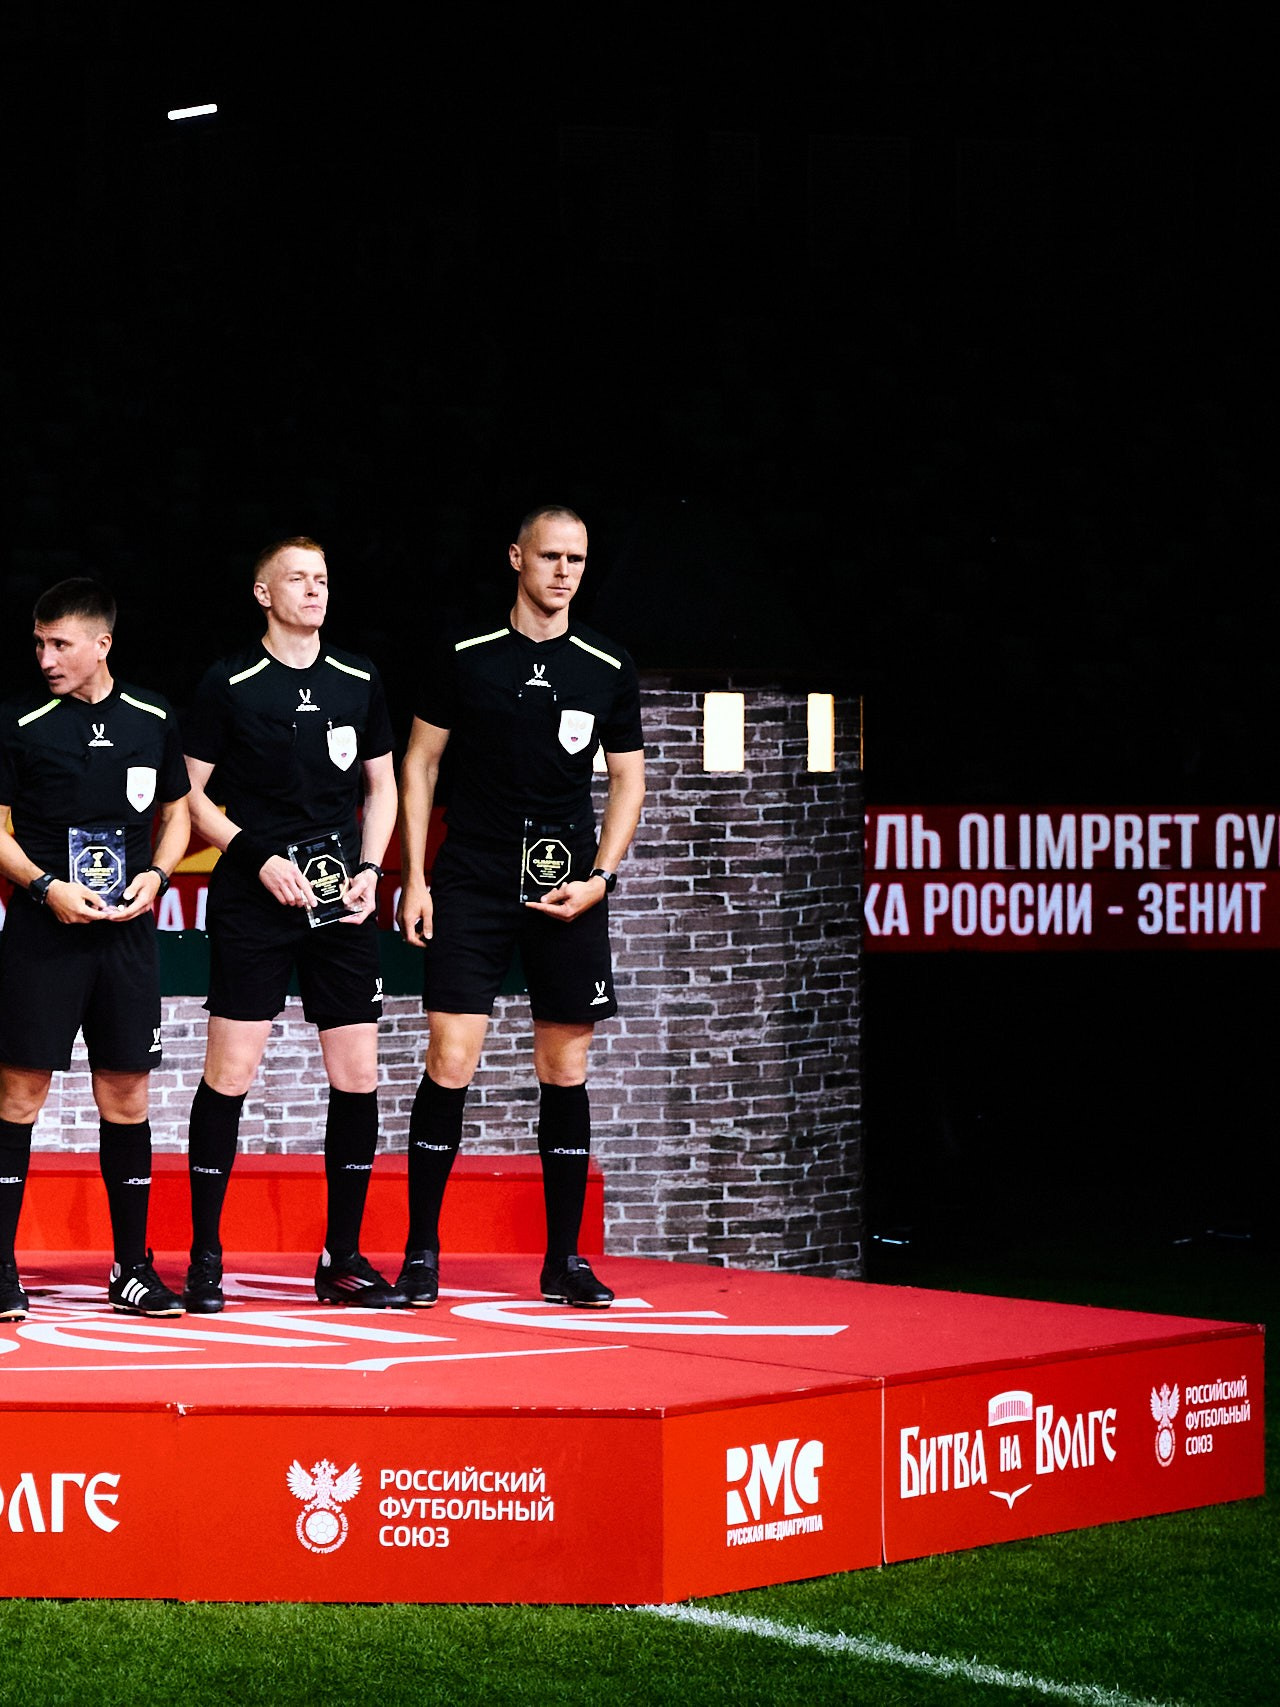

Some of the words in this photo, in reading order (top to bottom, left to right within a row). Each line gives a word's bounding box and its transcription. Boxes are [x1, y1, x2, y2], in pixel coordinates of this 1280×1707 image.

[924, 882, 1093, 936] РОССИИ
[1137, 882, 1267, 936] ЗЕНИТ
[1185, 1375, 1249, 1406] РОССИЙСКИЙ
[1185, 1399, 1251, 1431] ФУТБОЛЬНЫЙ
[1185, 1433, 1214, 1456] СОЮЗ
[380, 1465, 546, 1493] РОССИЙСКИЙ
[726, 1438, 824, 1526] RMG
[378, 1495, 555, 1523] ФУТБОЛЬНЫЙ
[378, 1525, 450, 1548] СОЮЗ
[726, 1524, 764, 1547] РУССКАЯ
[765, 1514, 824, 1542] МЕДИАГРУППА
